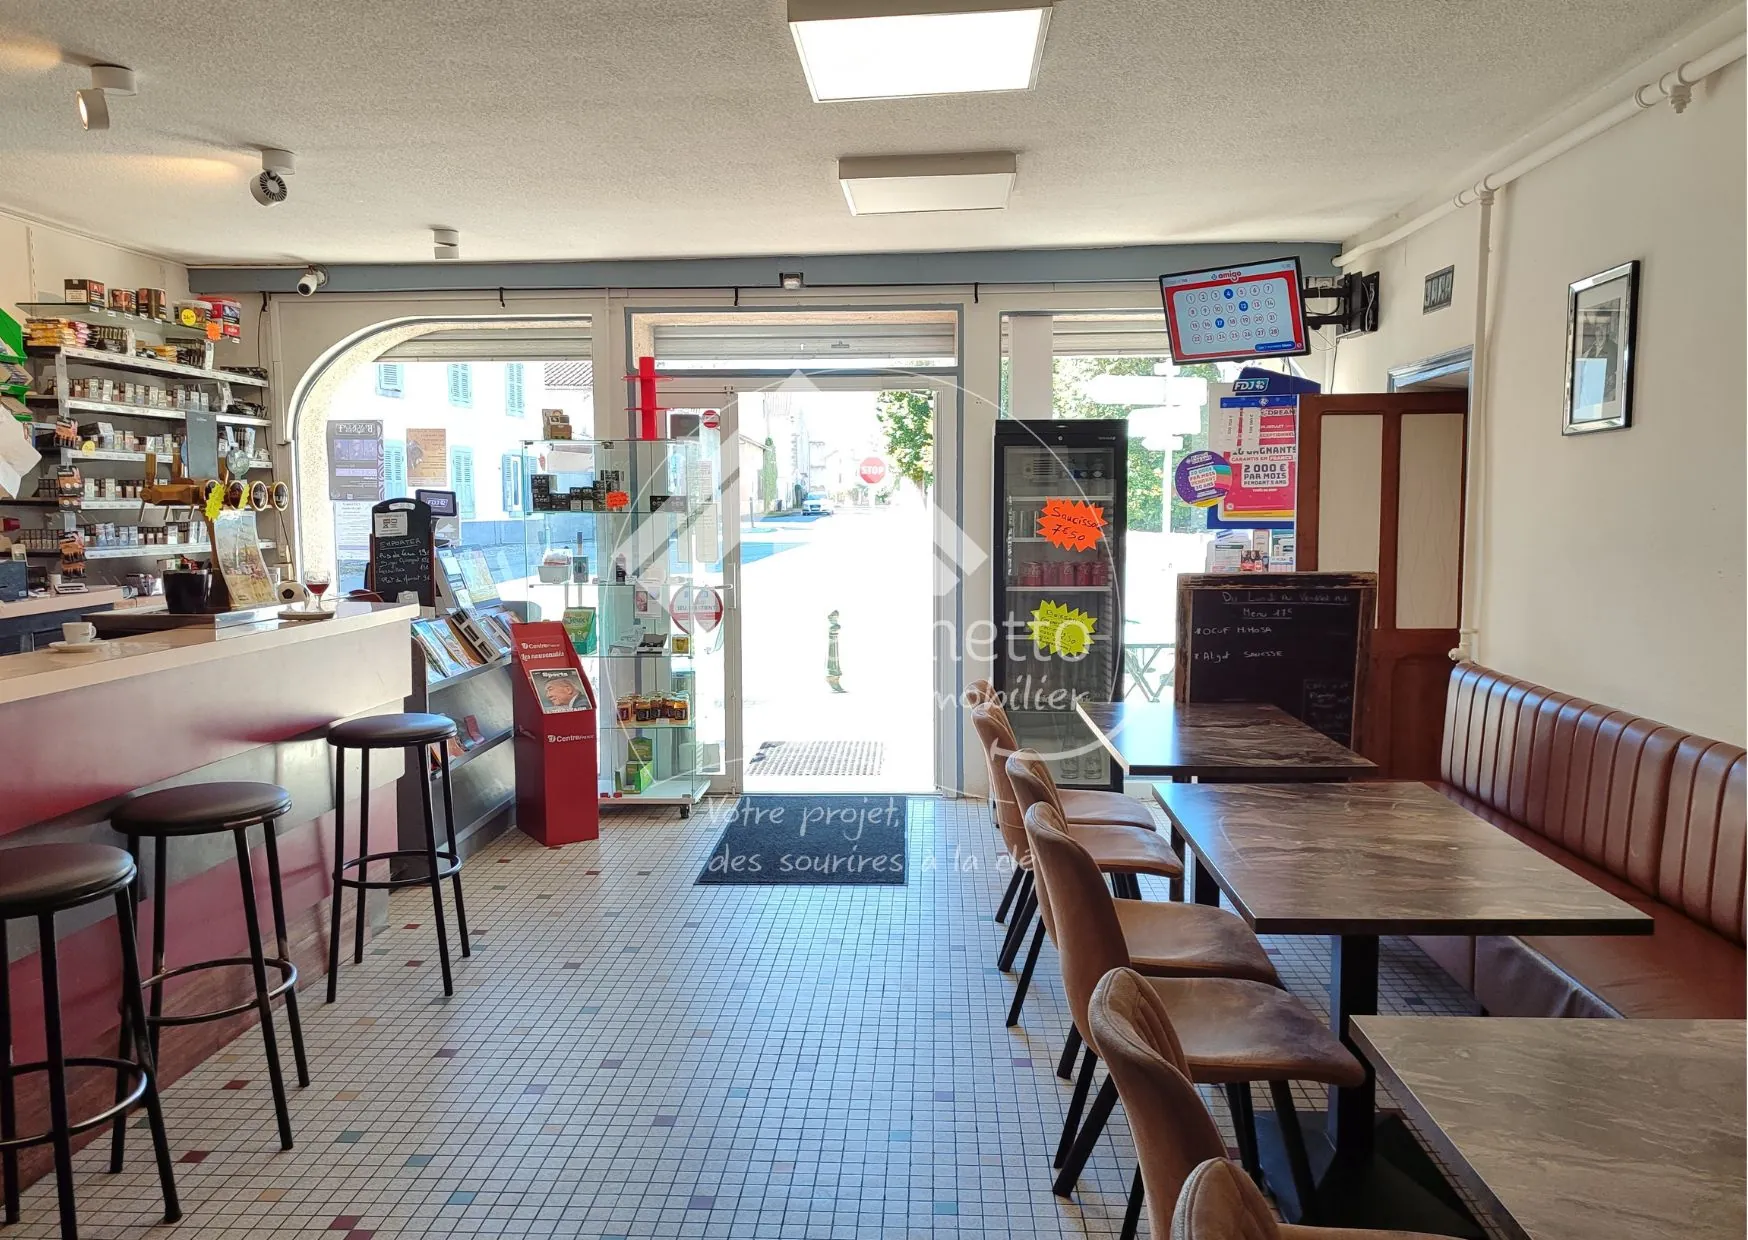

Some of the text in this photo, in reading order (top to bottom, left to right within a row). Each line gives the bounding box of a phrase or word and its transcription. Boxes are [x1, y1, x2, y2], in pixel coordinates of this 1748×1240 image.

[1218, 271, 1242, 281] amigo
[1234, 381, 1256, 391] FDJ
[861, 465, 885, 475] STOP
[1244, 463, 1287, 473] 2 000 €
[1263, 472, 1287, 480] MOIS
[1222, 591, 1237, 603] Du
[1243, 607, 1267, 618] Menu
